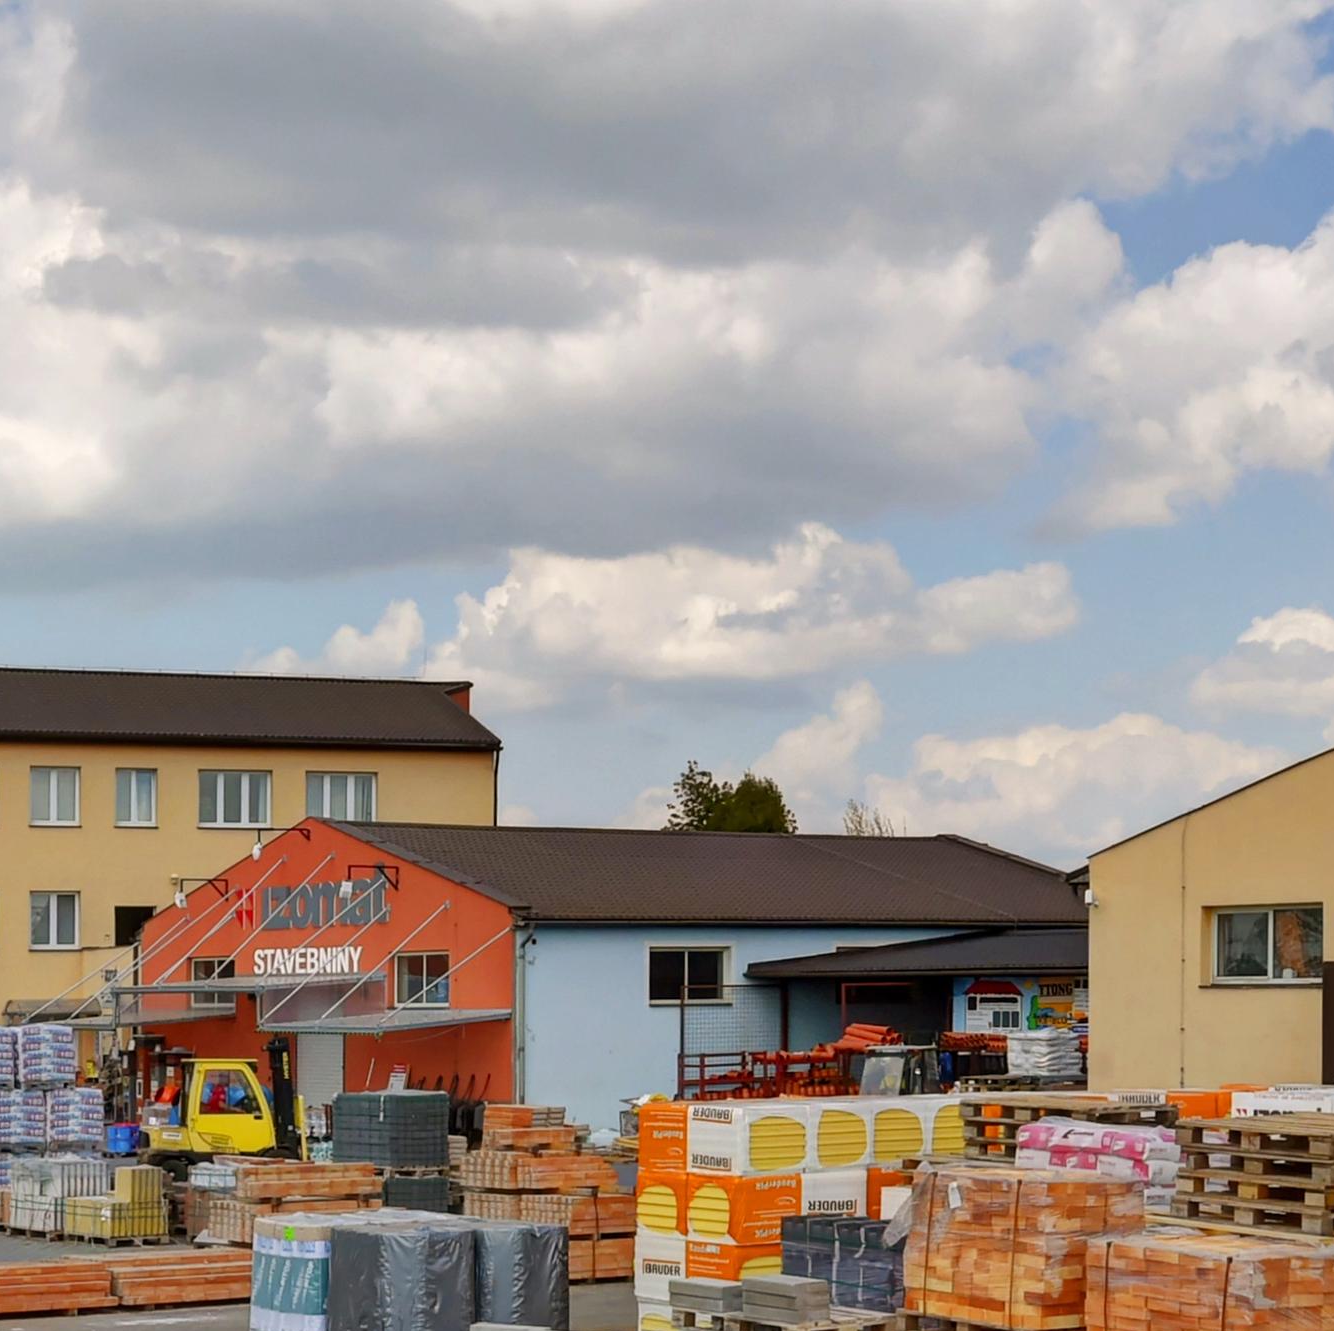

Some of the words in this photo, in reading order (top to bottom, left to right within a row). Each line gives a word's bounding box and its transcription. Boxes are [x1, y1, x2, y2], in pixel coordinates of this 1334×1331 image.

[253, 946, 363, 974] STAVEBNINY
[692, 1107, 730, 1120] BAUDER
[691, 1153, 730, 1168] BAUDER
[807, 1200, 855, 1211] BAUDER
[644, 1263, 681, 1276] BAUDER
